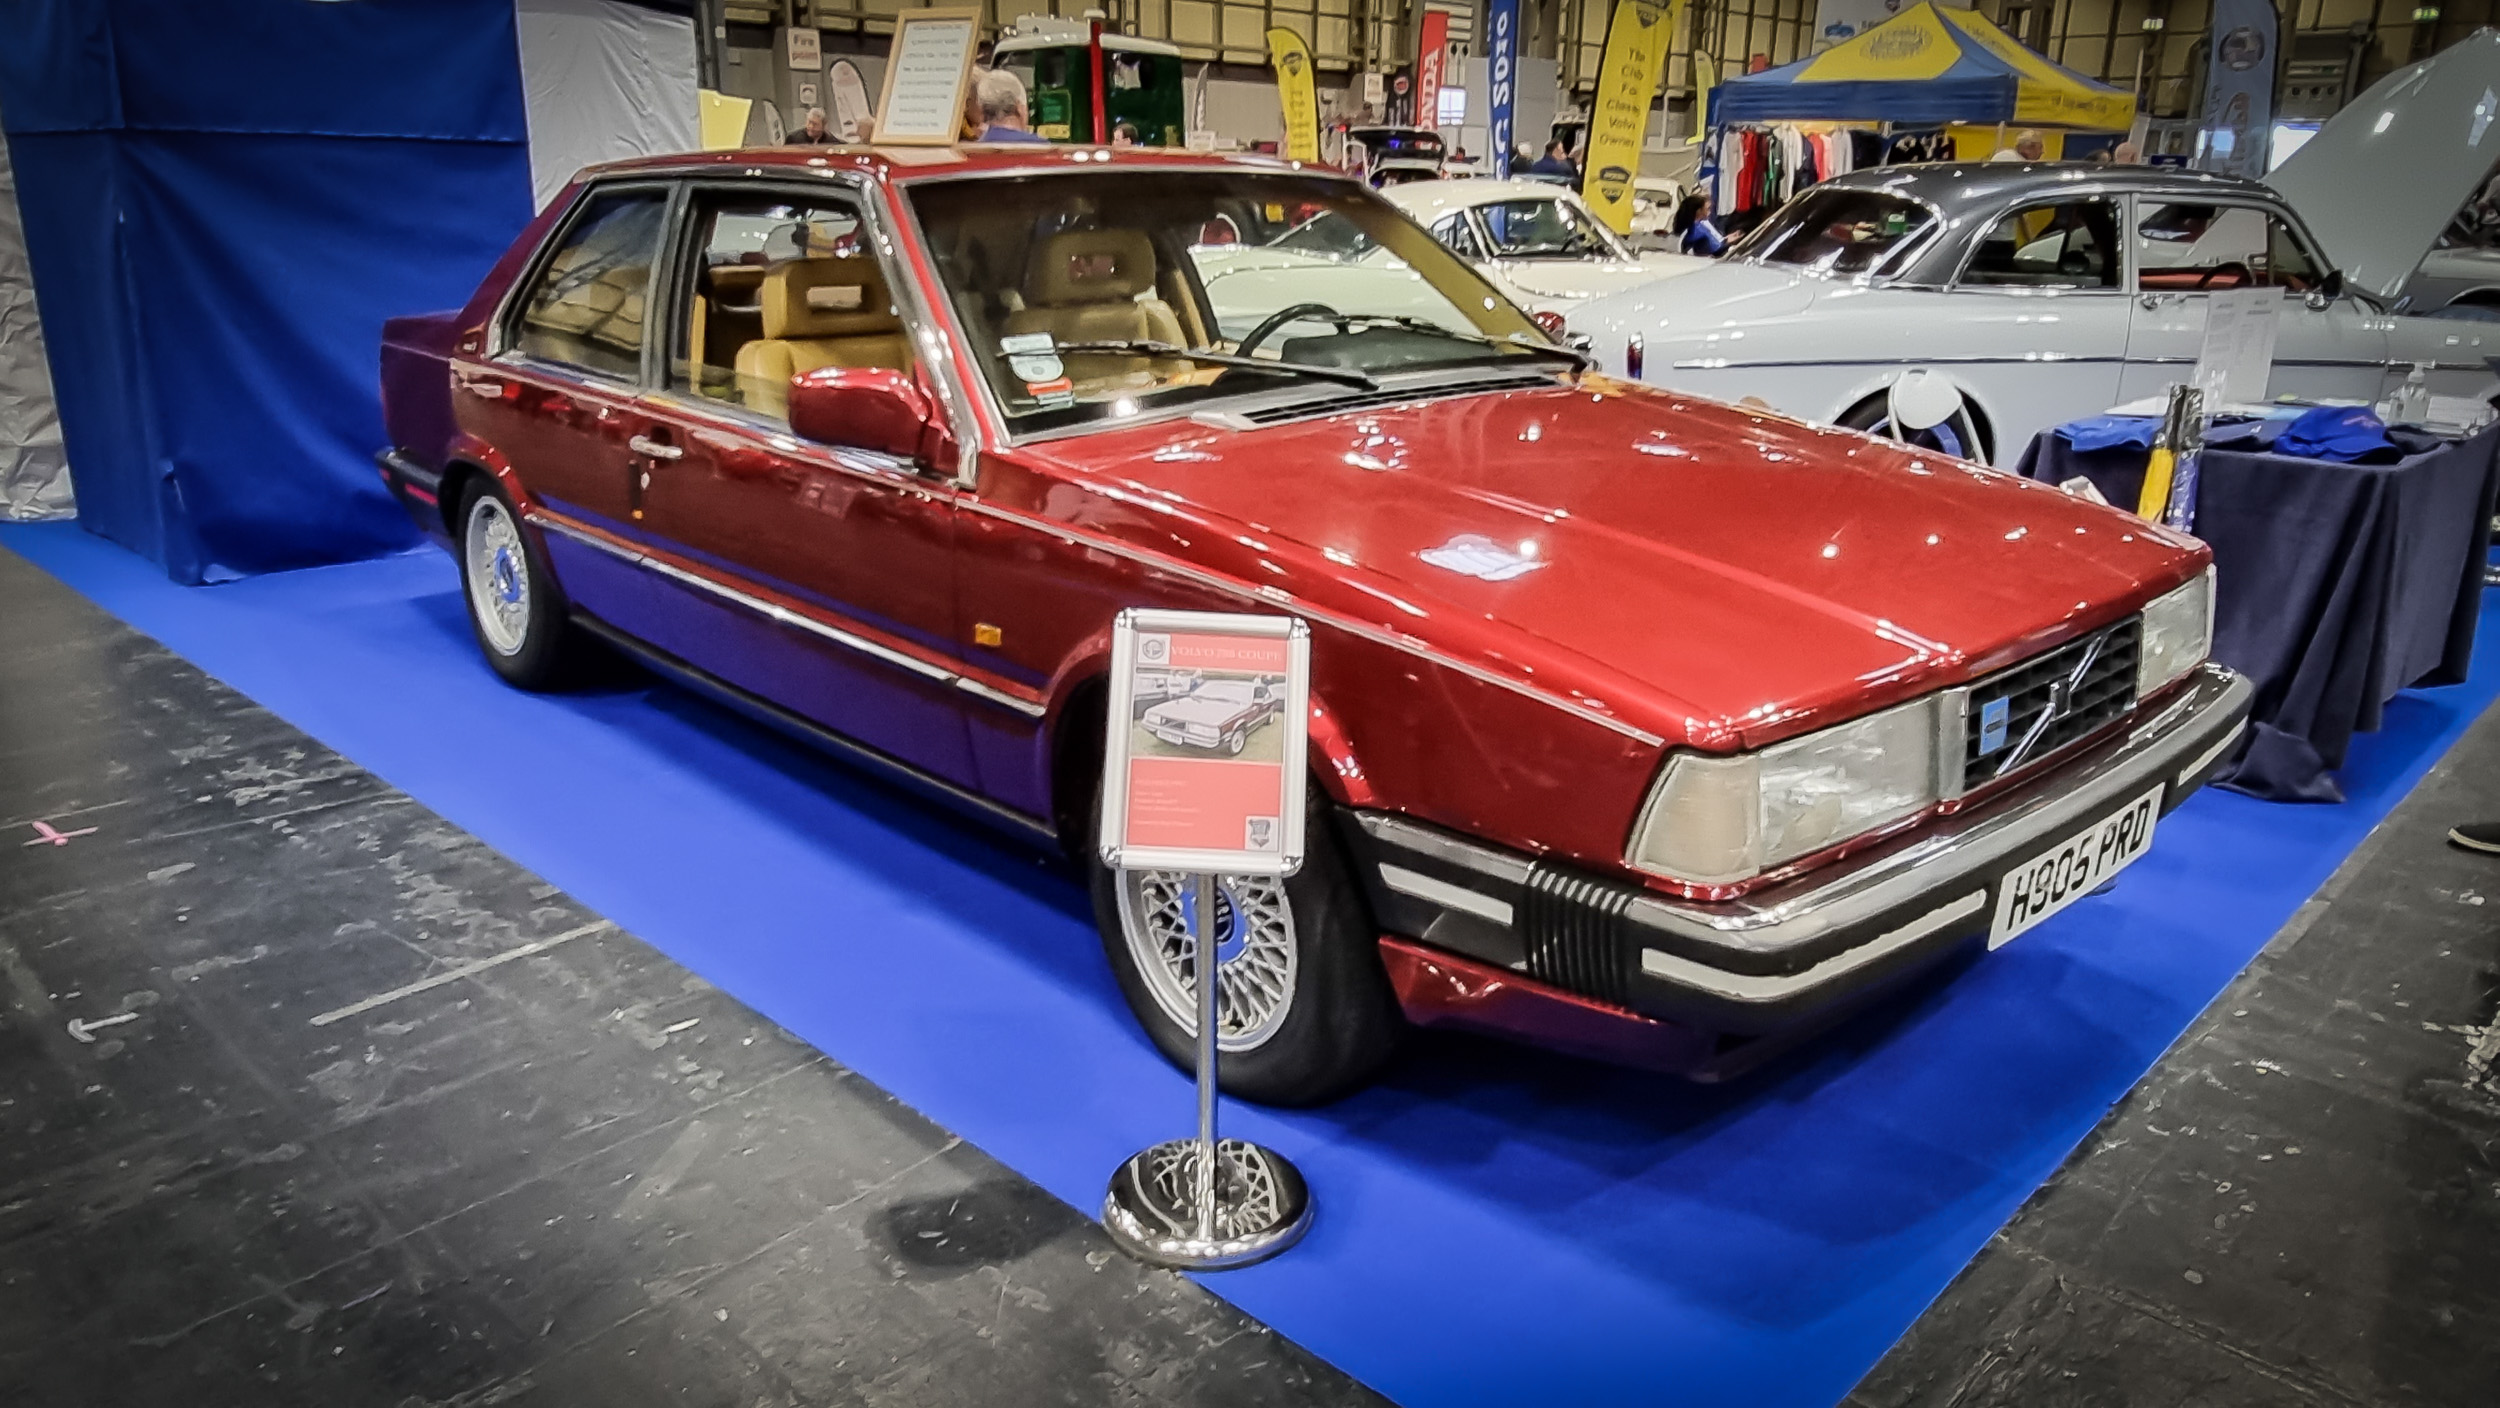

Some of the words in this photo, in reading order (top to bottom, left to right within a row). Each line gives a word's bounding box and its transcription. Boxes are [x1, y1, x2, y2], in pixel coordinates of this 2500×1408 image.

[1420, 48, 1440, 131] ONDA
[1608, 116, 1636, 130] Volv
[2007, 832, 2094, 931] H905
[2095, 798, 2151, 877] PRD
